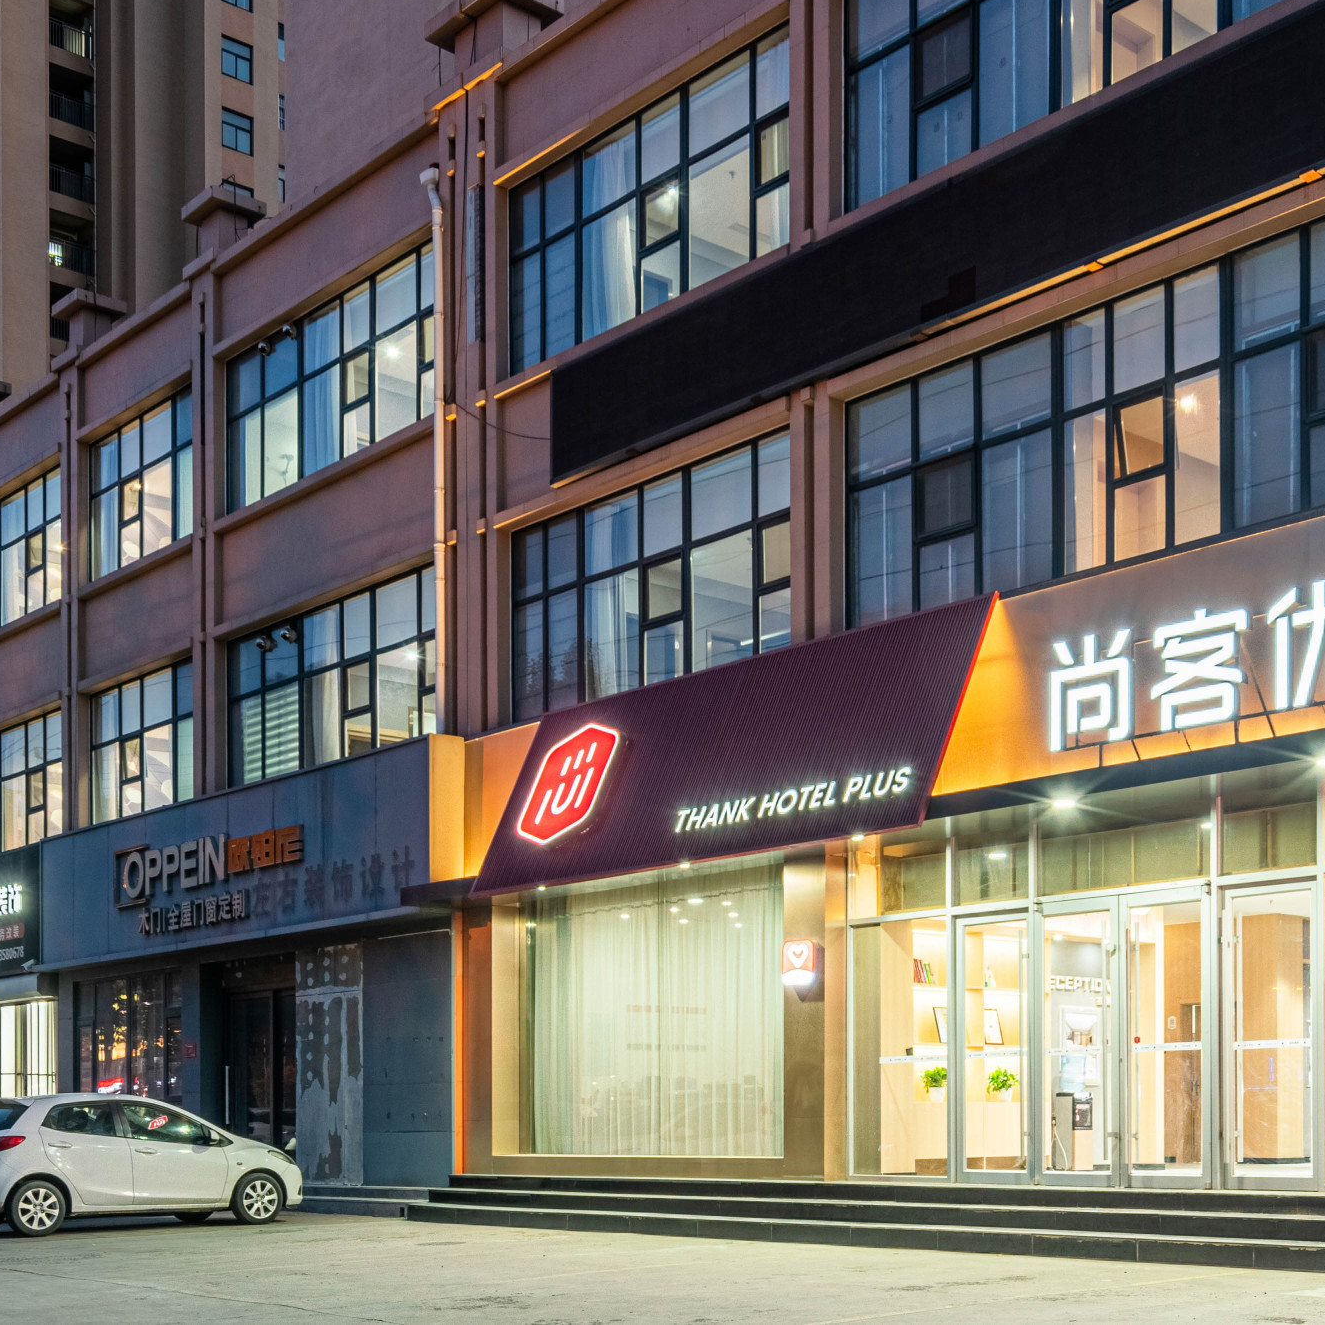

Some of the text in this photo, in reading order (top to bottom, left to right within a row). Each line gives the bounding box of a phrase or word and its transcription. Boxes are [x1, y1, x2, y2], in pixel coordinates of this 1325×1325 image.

[674, 766, 913, 834] THANK HOTEL PLUS
[124, 833, 227, 900] OPPEIN
